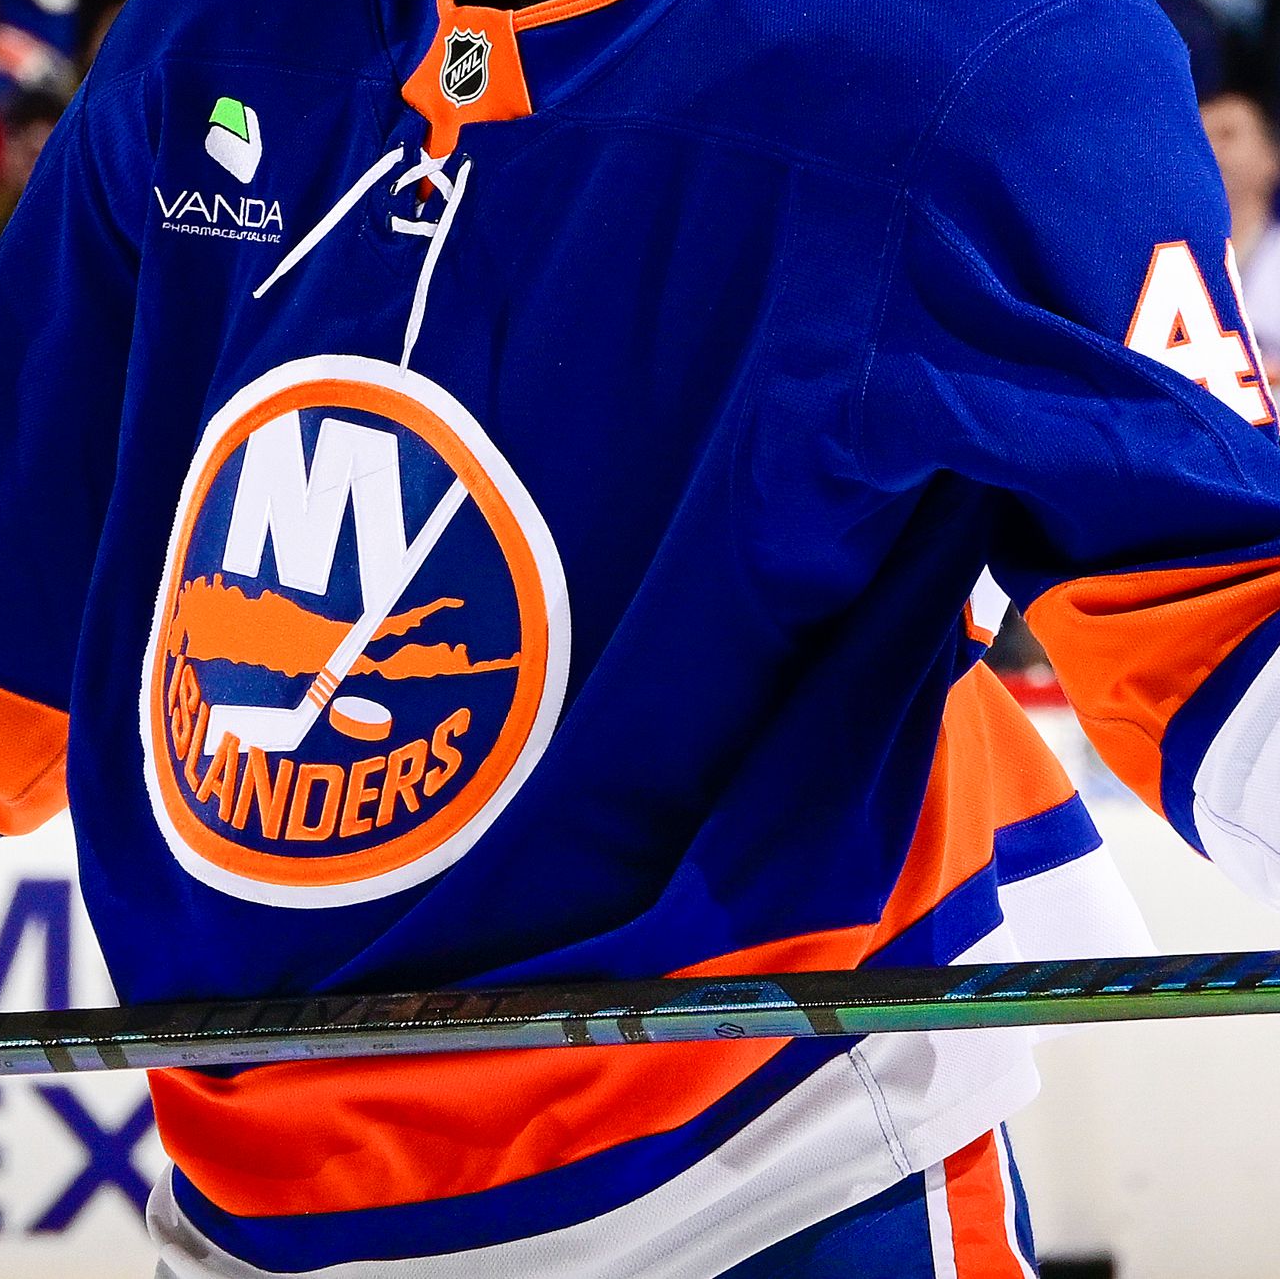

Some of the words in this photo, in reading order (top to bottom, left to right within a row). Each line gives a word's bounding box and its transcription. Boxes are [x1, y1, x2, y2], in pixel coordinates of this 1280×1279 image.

[449, 50, 481, 88] NHL
[154, 186, 283, 230] VANDA
[168, 654, 471, 841] ISLANDERS
